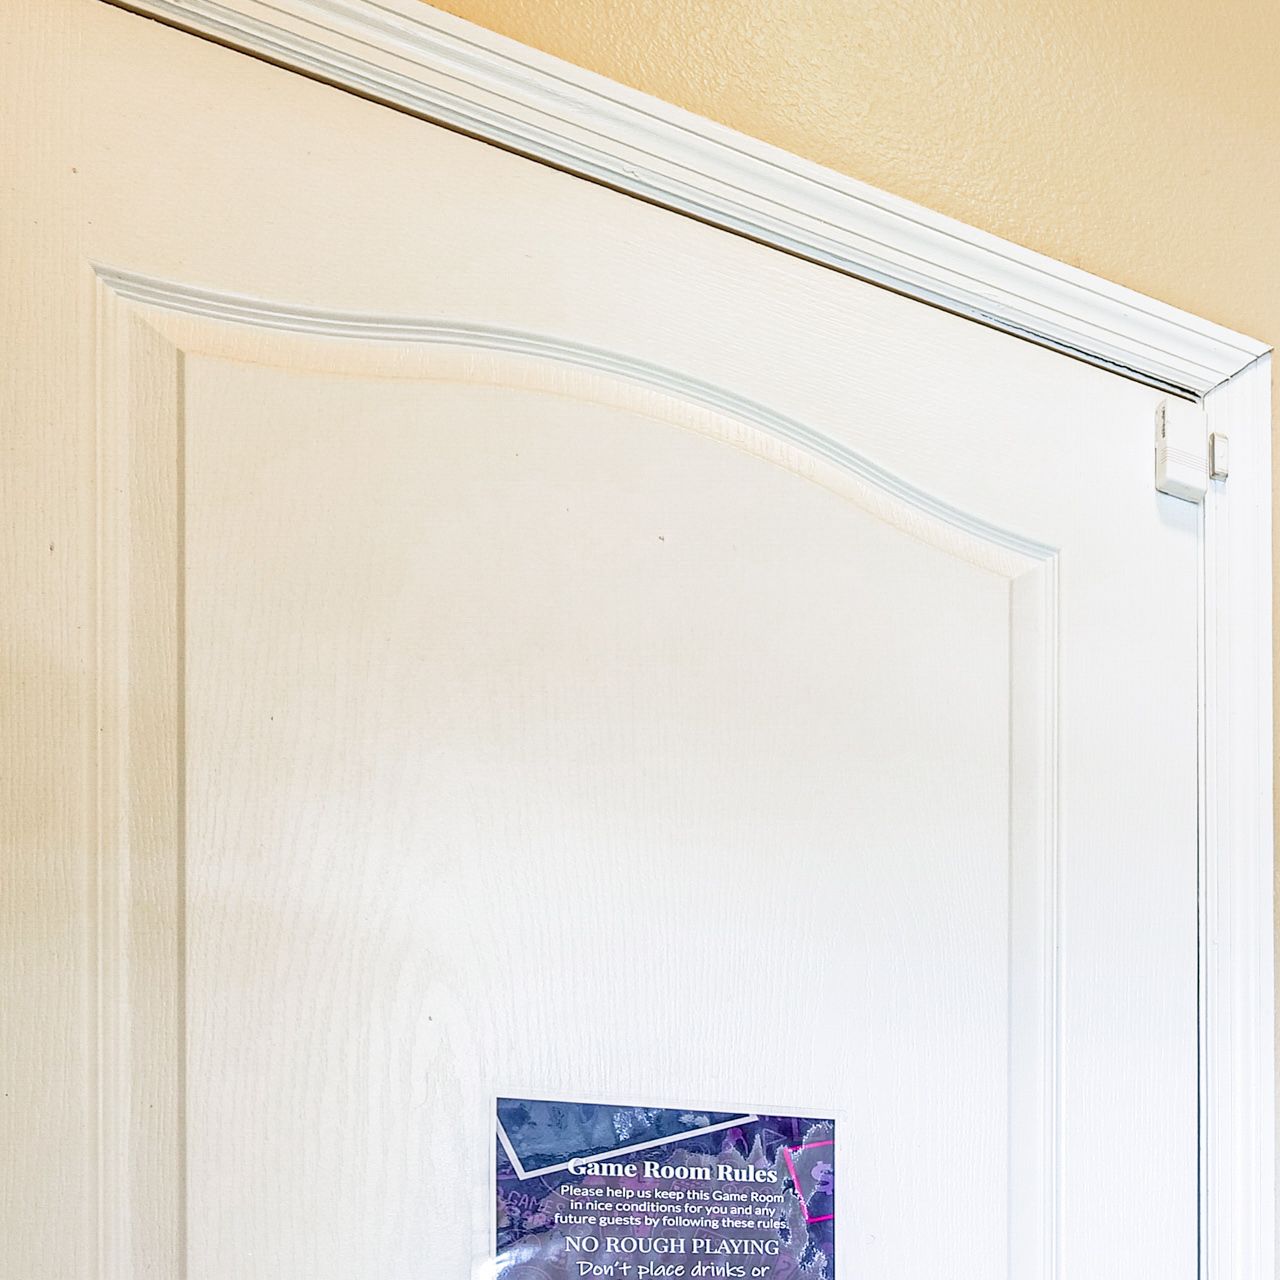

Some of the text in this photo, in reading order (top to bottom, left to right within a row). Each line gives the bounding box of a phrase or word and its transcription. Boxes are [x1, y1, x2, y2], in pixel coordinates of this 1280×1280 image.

[567, 1158, 777, 1184] Game Room Rules
[560, 1185, 784, 1203] Please help us keep this Game Room
[570, 1200, 776, 1218] in nice conditions for you and any
[554, 1213, 790, 1230] future guests by following these rules.
[564, 1236, 780, 1255] NO ROUGH PLAYING
[576, 1260, 770, 1279] Don't place drinks or
